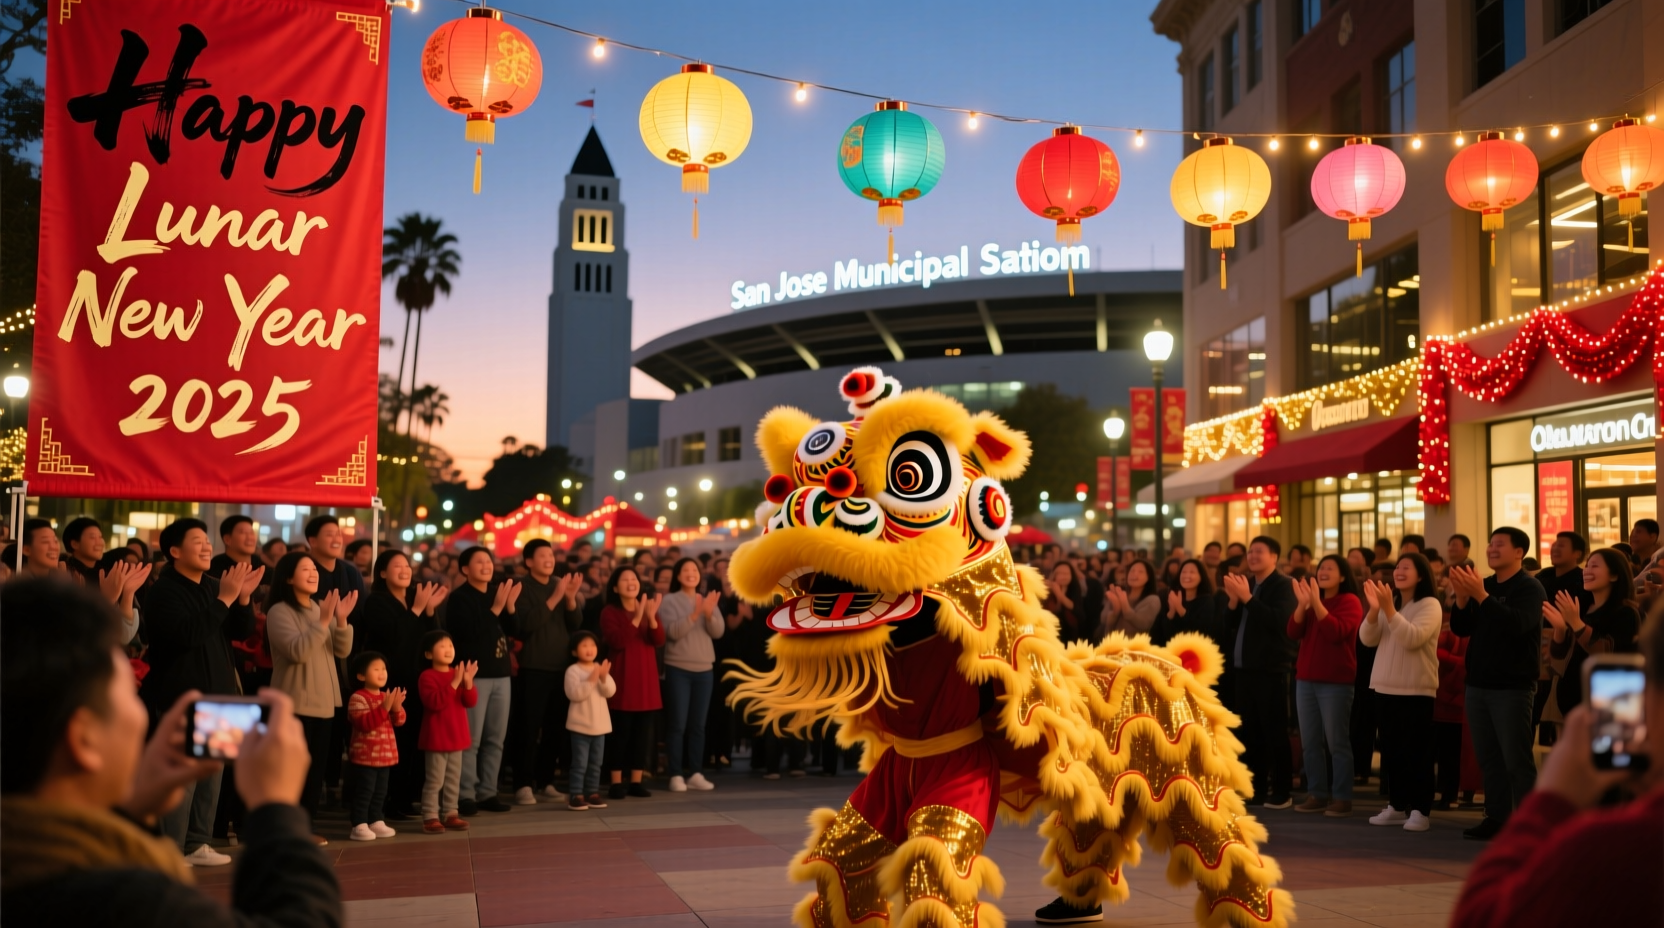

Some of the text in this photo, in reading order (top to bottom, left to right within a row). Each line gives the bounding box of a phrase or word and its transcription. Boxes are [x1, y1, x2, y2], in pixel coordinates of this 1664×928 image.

[67, 23, 366, 197] Happy
[97, 161, 329, 264] Lunar
[57, 266, 367, 371] New Year
[730, 280, 771, 310] San
[774, 271, 828, 302] Jose
[834, 245, 969, 290] Municipal
[118, 374, 313, 456] 2025
